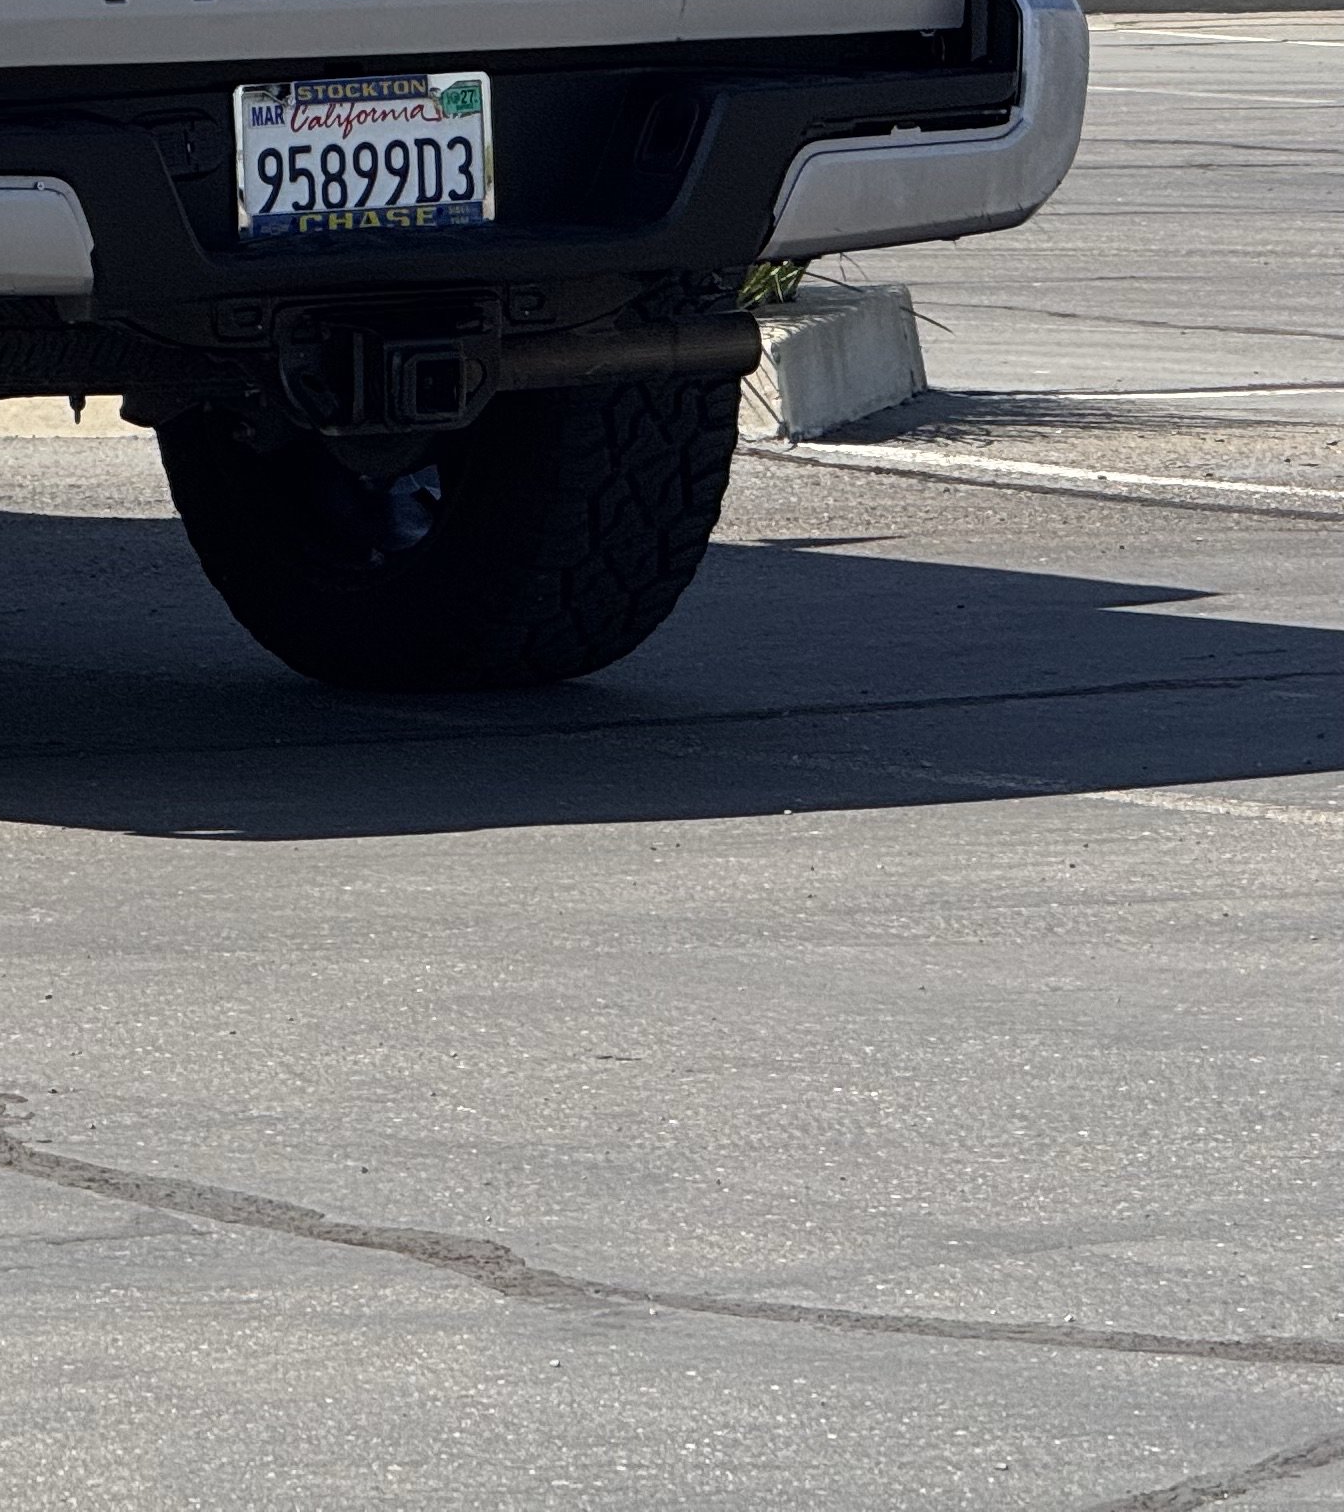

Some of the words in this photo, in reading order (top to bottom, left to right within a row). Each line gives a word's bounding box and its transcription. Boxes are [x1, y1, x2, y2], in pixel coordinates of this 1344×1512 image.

[297, 79, 426, 101] STOCKTON
[251, 106, 285, 126] MAR
[290, 102, 442, 140] California
[257, 136, 476, 213] 95899D3
[298, 206, 436, 233] CHASE
